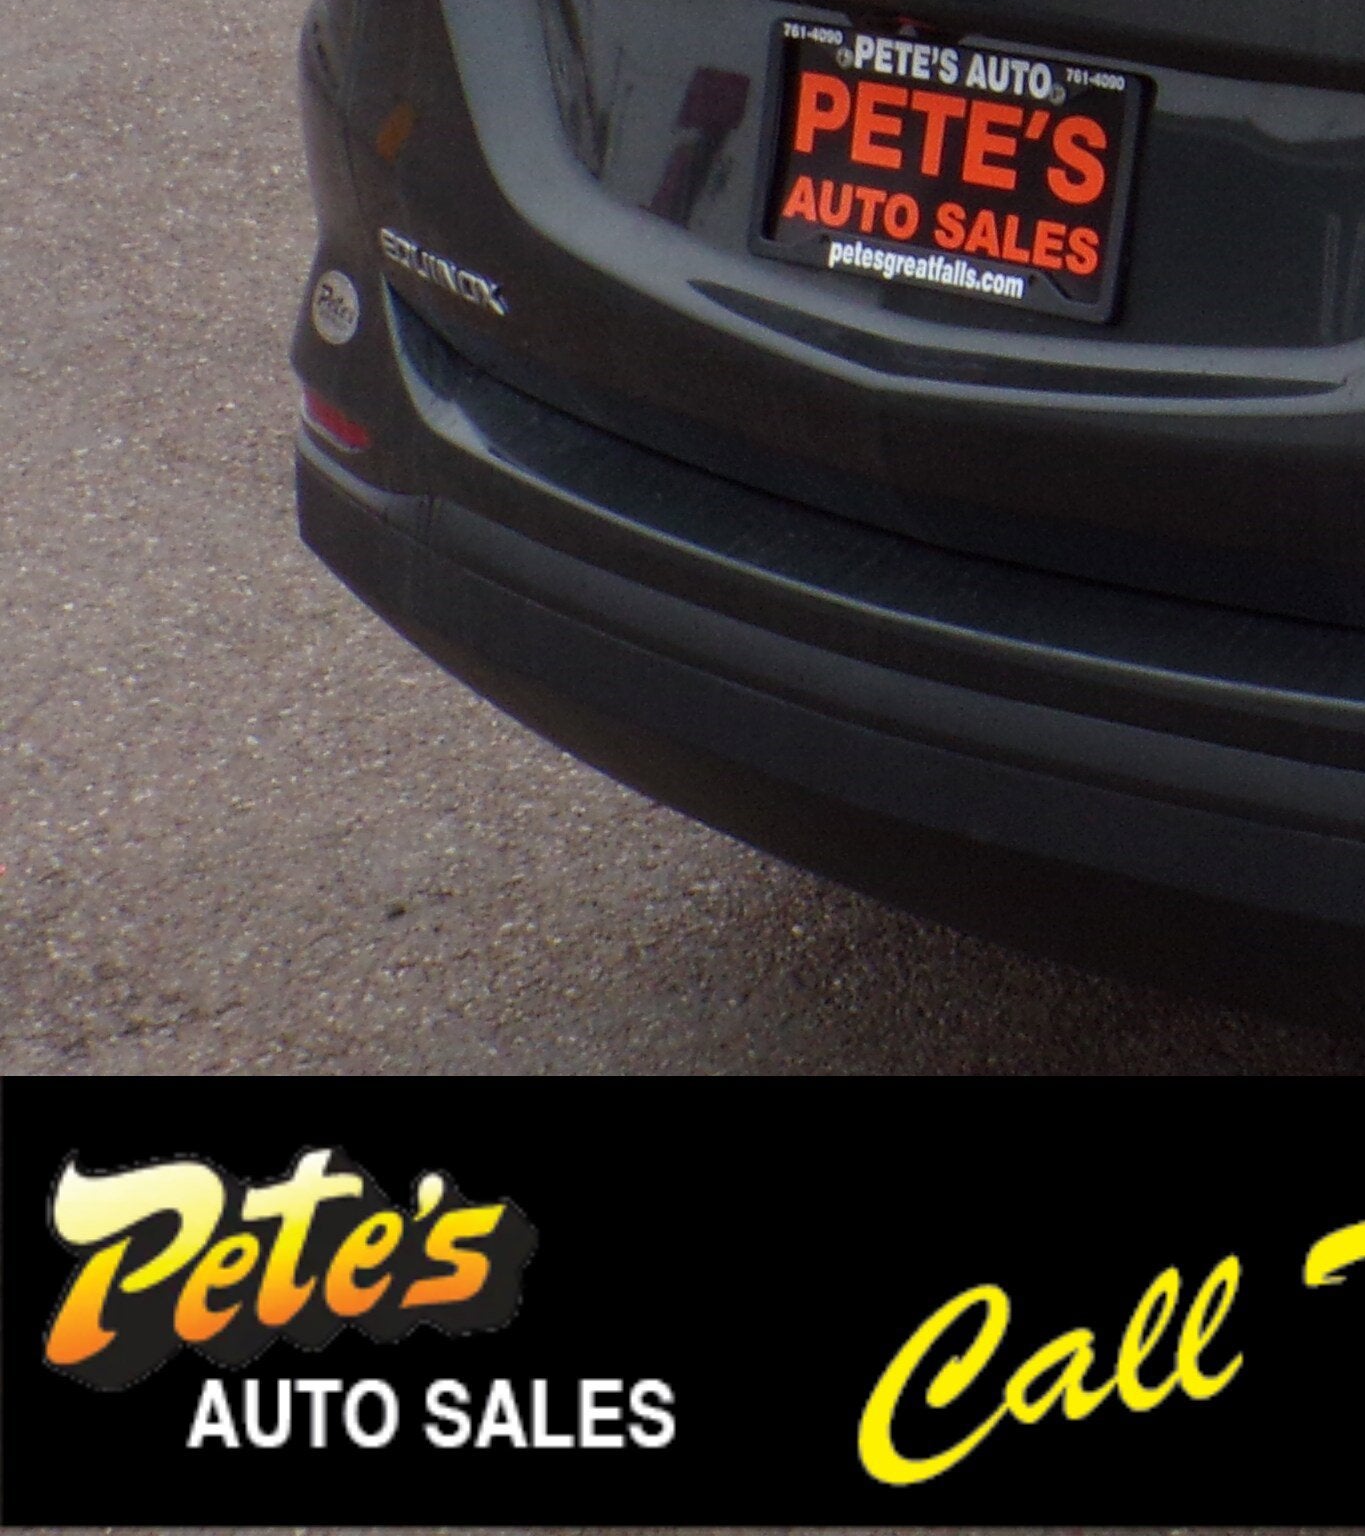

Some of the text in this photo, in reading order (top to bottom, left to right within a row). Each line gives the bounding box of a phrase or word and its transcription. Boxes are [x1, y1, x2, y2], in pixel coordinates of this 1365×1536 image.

[783, 21, 844, 47] 761-4090
[853, 34, 1054, 100] PETE'S AUTO
[1065, 67, 1126, 92] 761-4090
[794, 71, 1107, 205] PETE'S
[782, 175, 1100, 276] AUTO SALES
[827, 239, 1025, 300] petesgreatfalls.com
